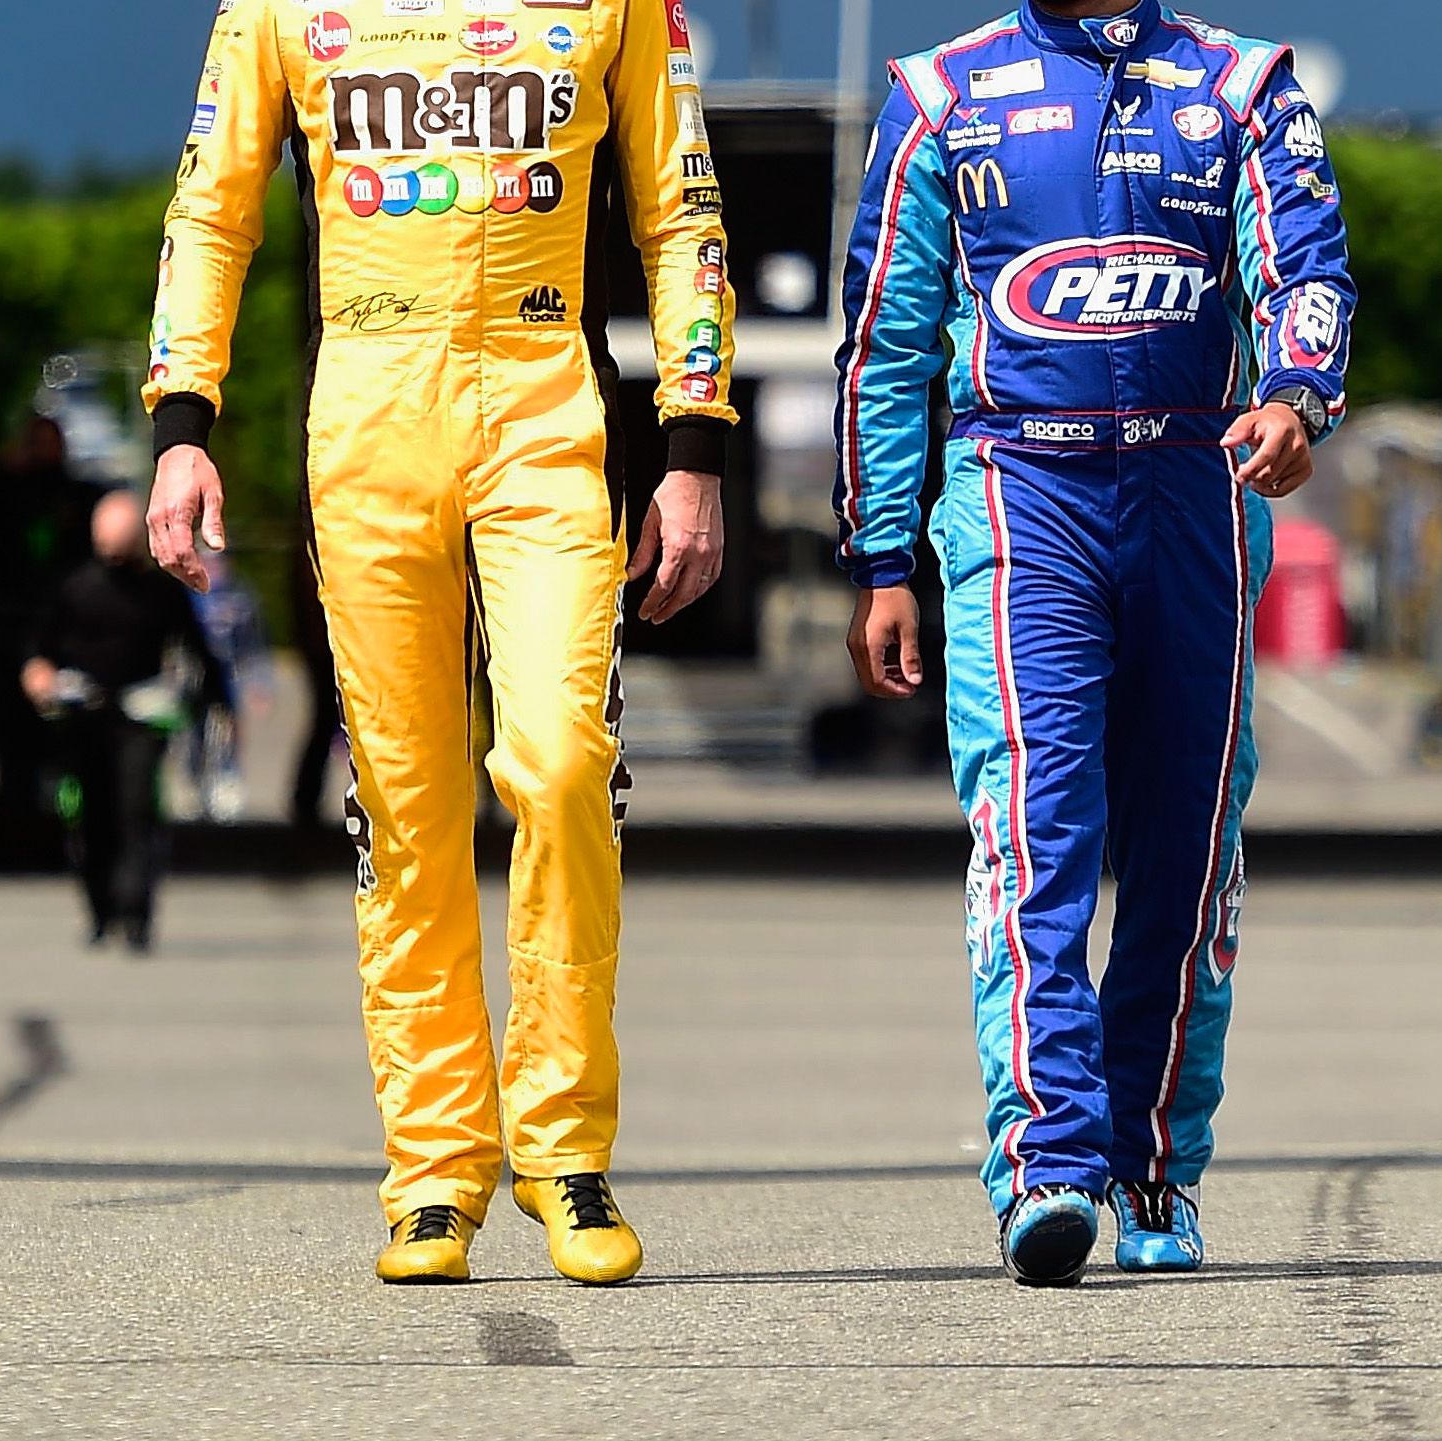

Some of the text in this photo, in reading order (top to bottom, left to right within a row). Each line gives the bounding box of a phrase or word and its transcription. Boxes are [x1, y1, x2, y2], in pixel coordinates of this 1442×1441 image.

[1106, 254, 1177, 268] RICHARD
[519, 285, 567, 313] MAC
[1042, 266, 1217, 315] PETTY
[518, 313, 566, 323] TOOLS
[1077, 311, 1197, 325] MOTORSPORTS
[1023, 420, 1095, 440] sparco
